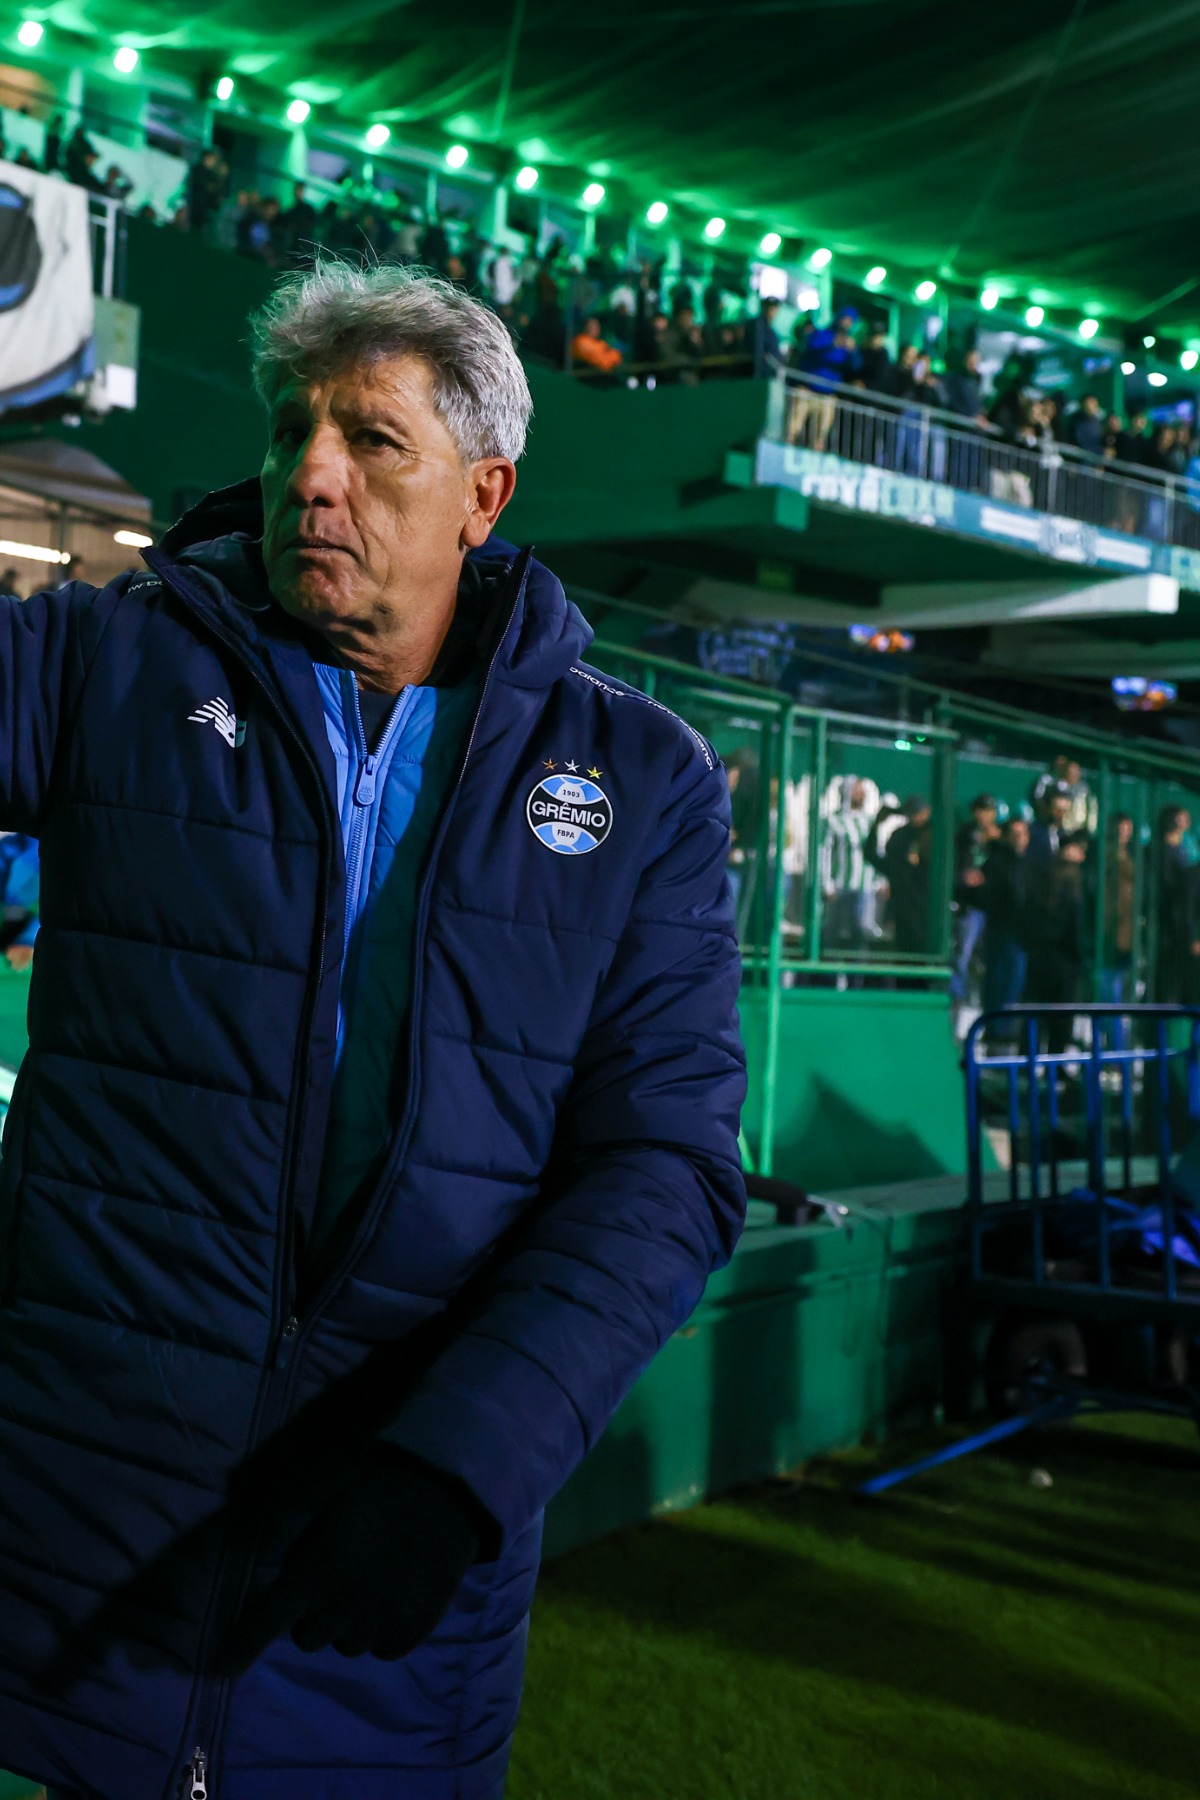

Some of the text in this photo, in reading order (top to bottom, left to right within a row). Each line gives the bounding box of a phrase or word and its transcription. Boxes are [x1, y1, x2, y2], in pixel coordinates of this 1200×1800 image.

[562, 789, 581, 799] 1903
[531, 801, 607, 828] GRÊMIO
[557, 829, 575, 839] FBPA
